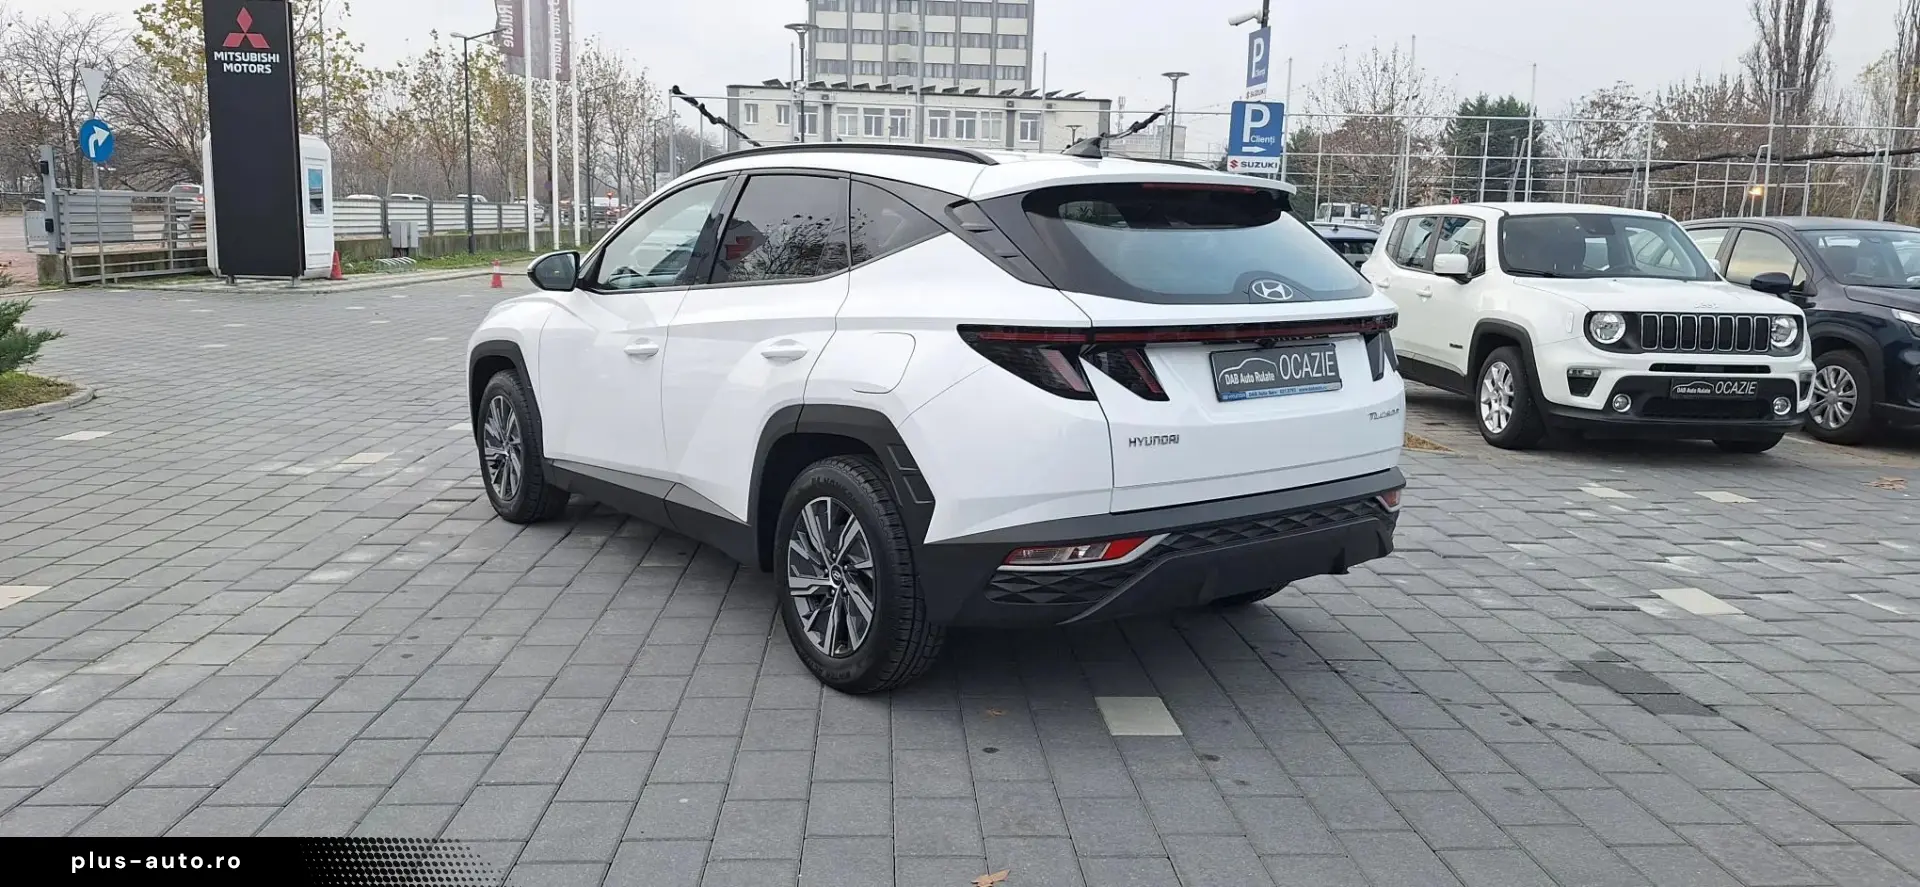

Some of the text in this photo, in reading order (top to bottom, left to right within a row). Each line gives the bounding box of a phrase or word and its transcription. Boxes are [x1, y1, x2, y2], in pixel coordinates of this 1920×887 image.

[213, 51, 280, 63] MITSUBISHI
[1252, 37, 1265, 79] P
[223, 63, 272, 74] MOTORS
[1242, 103, 1271, 143] P
[1240, 160, 1278, 169] SUZUKI
[1279, 351, 1336, 380] OCAZIE
[1225, 371, 1275, 385] DAB Auto Rulate
[1715, 381, 1757, 394] OCAZIE
[1128, 434, 1180, 447] HYUNDAI
